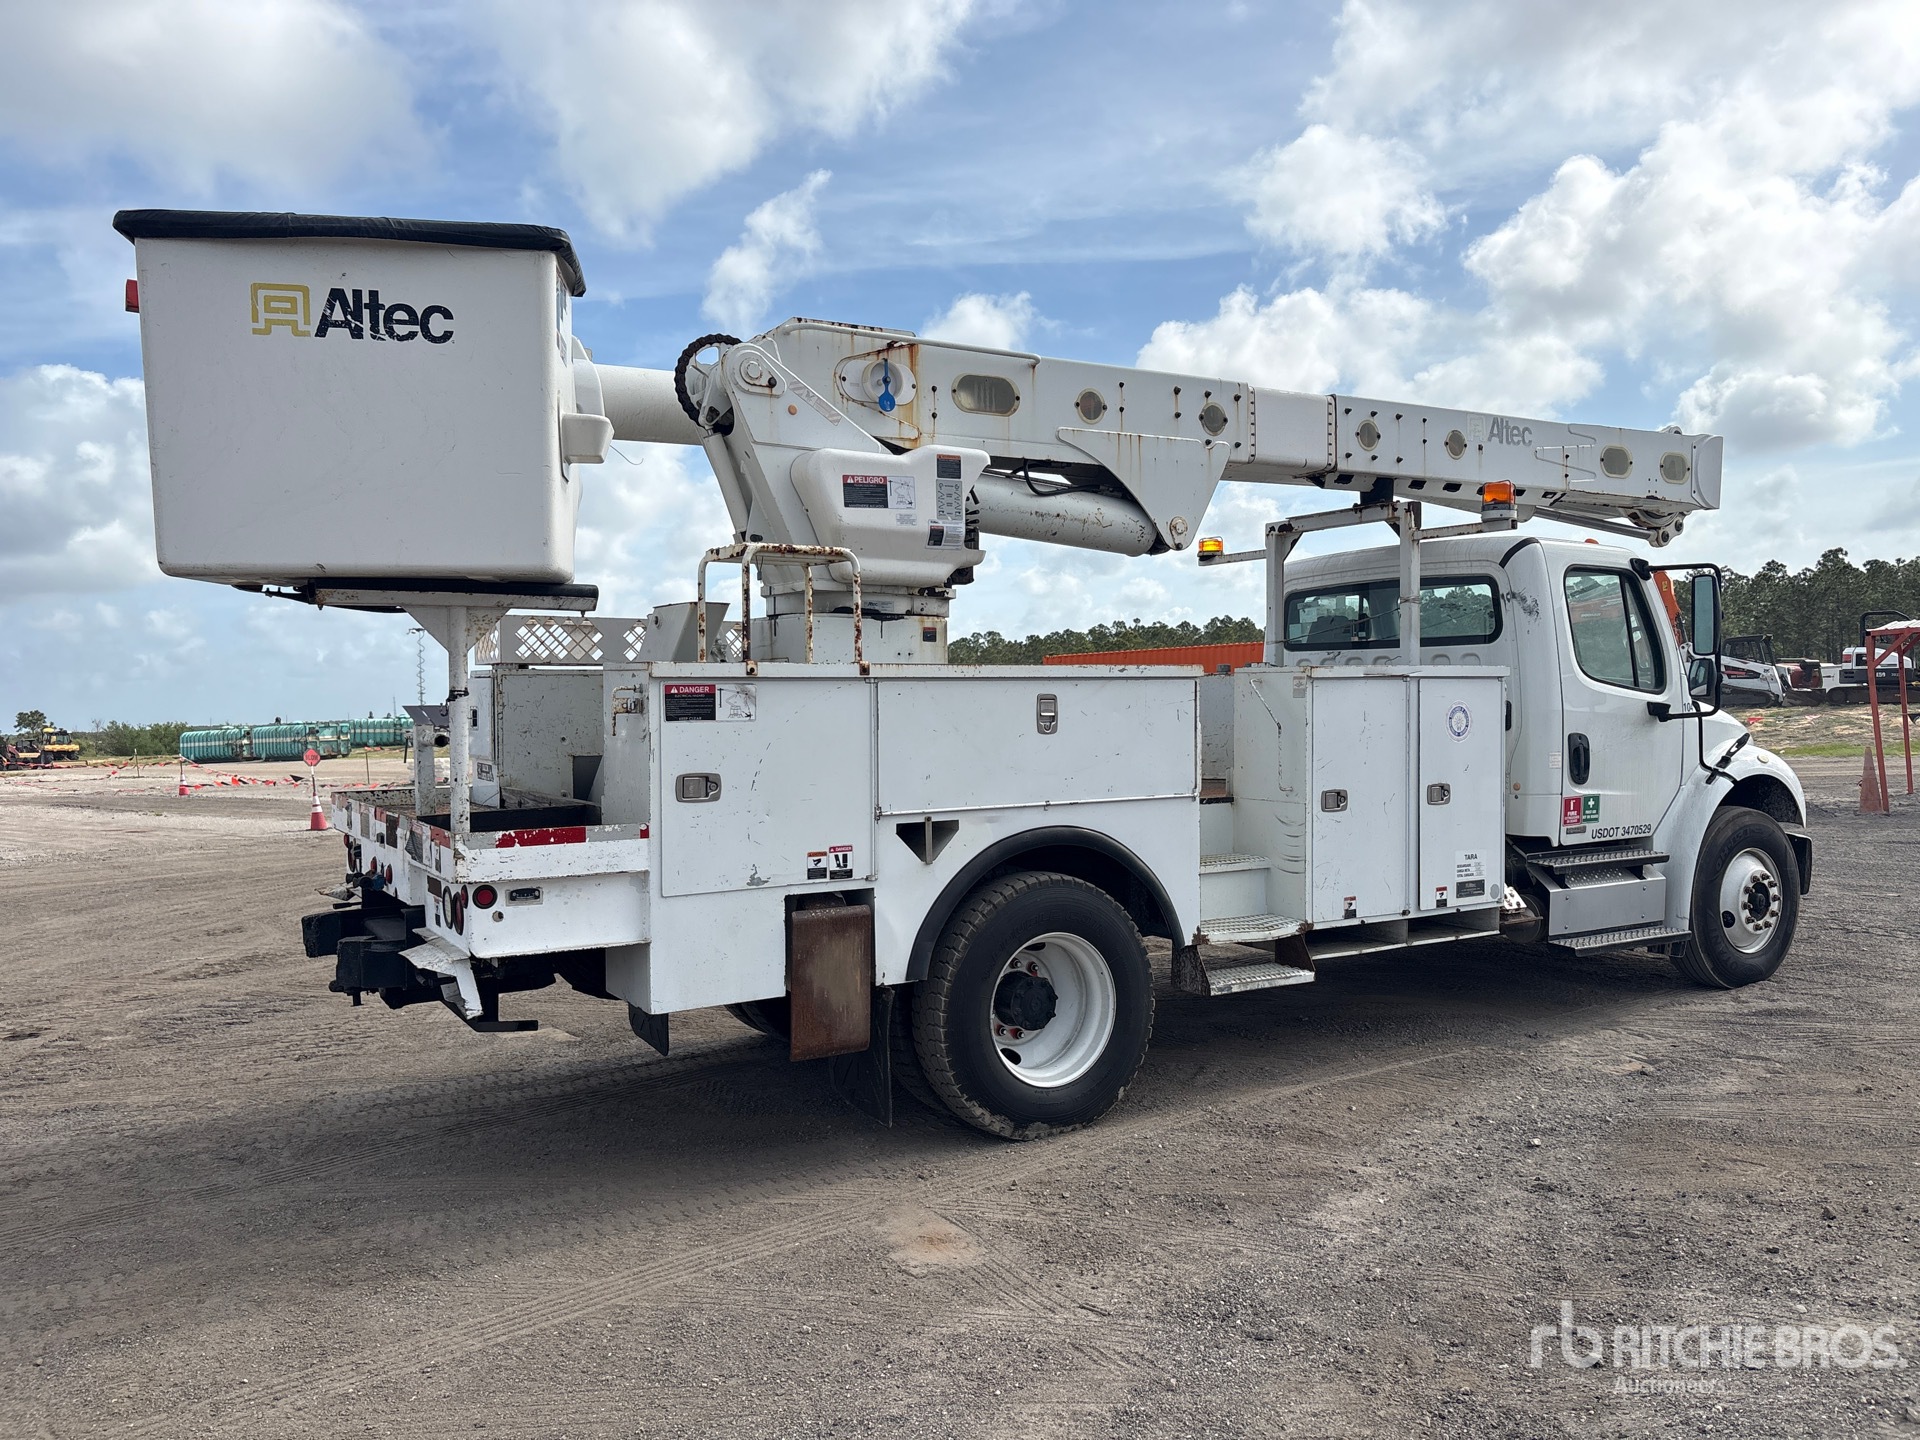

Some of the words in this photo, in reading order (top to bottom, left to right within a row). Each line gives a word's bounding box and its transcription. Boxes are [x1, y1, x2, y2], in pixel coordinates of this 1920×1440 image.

[314, 287, 454, 344] Altec
[1488, 416, 1532, 447] Altec
[854, 476, 884, 484] PELIGRO
[1591, 826, 1620, 840] USDOT
[1621, 824, 1652, 837] 3470529
